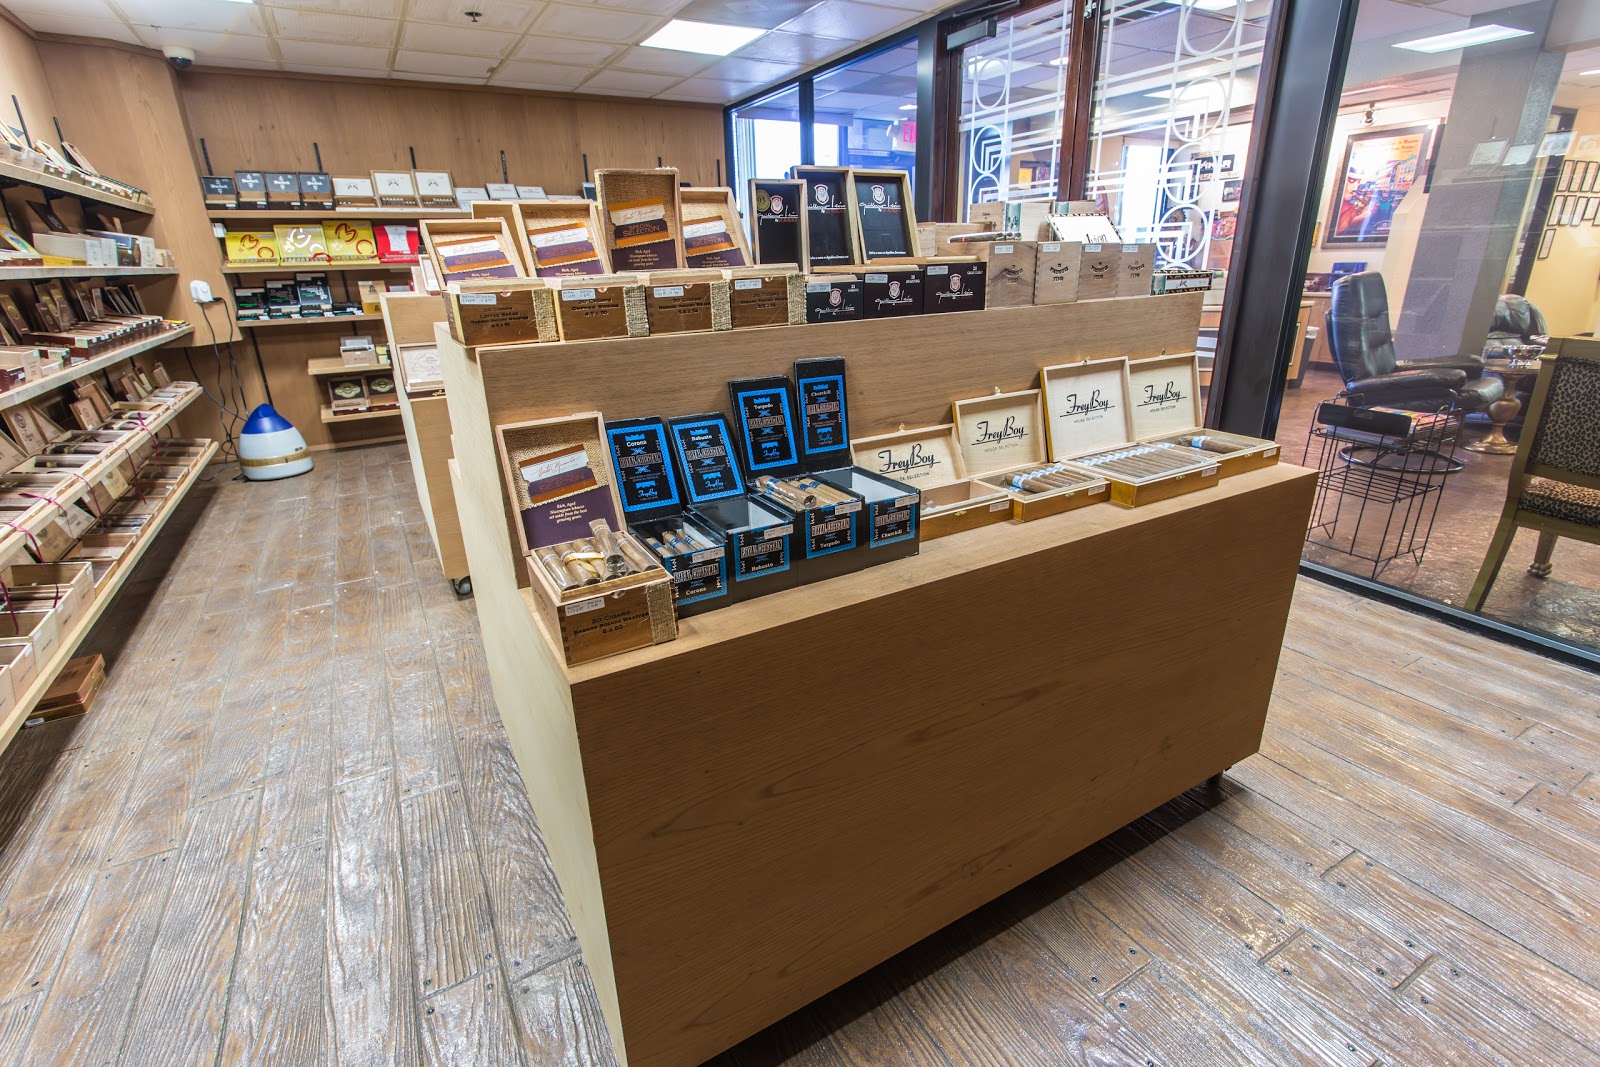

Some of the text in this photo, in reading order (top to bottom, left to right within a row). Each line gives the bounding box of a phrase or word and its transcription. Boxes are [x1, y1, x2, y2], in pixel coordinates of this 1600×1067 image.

[904, 122, 917, 142] EXI
[622, 226, 660, 236] SELECTION
[1144, 381, 1181, 405] FreyBoy
[1066, 389, 1109, 415] FreyBoy
[976, 416, 1024, 444] FreyBoy
[878, 443, 935, 474] FreyBoy
[906, 472, 930, 481] SELECTION
[820, 540, 840, 548] Torpedo
[752, 563, 774, 571] Robusto
[686, 587, 706, 595] Corona
[604, 611, 631, 620] CIGARS
[573, 625, 598, 636] HABANO
[600, 619, 622, 628] ROSADO
